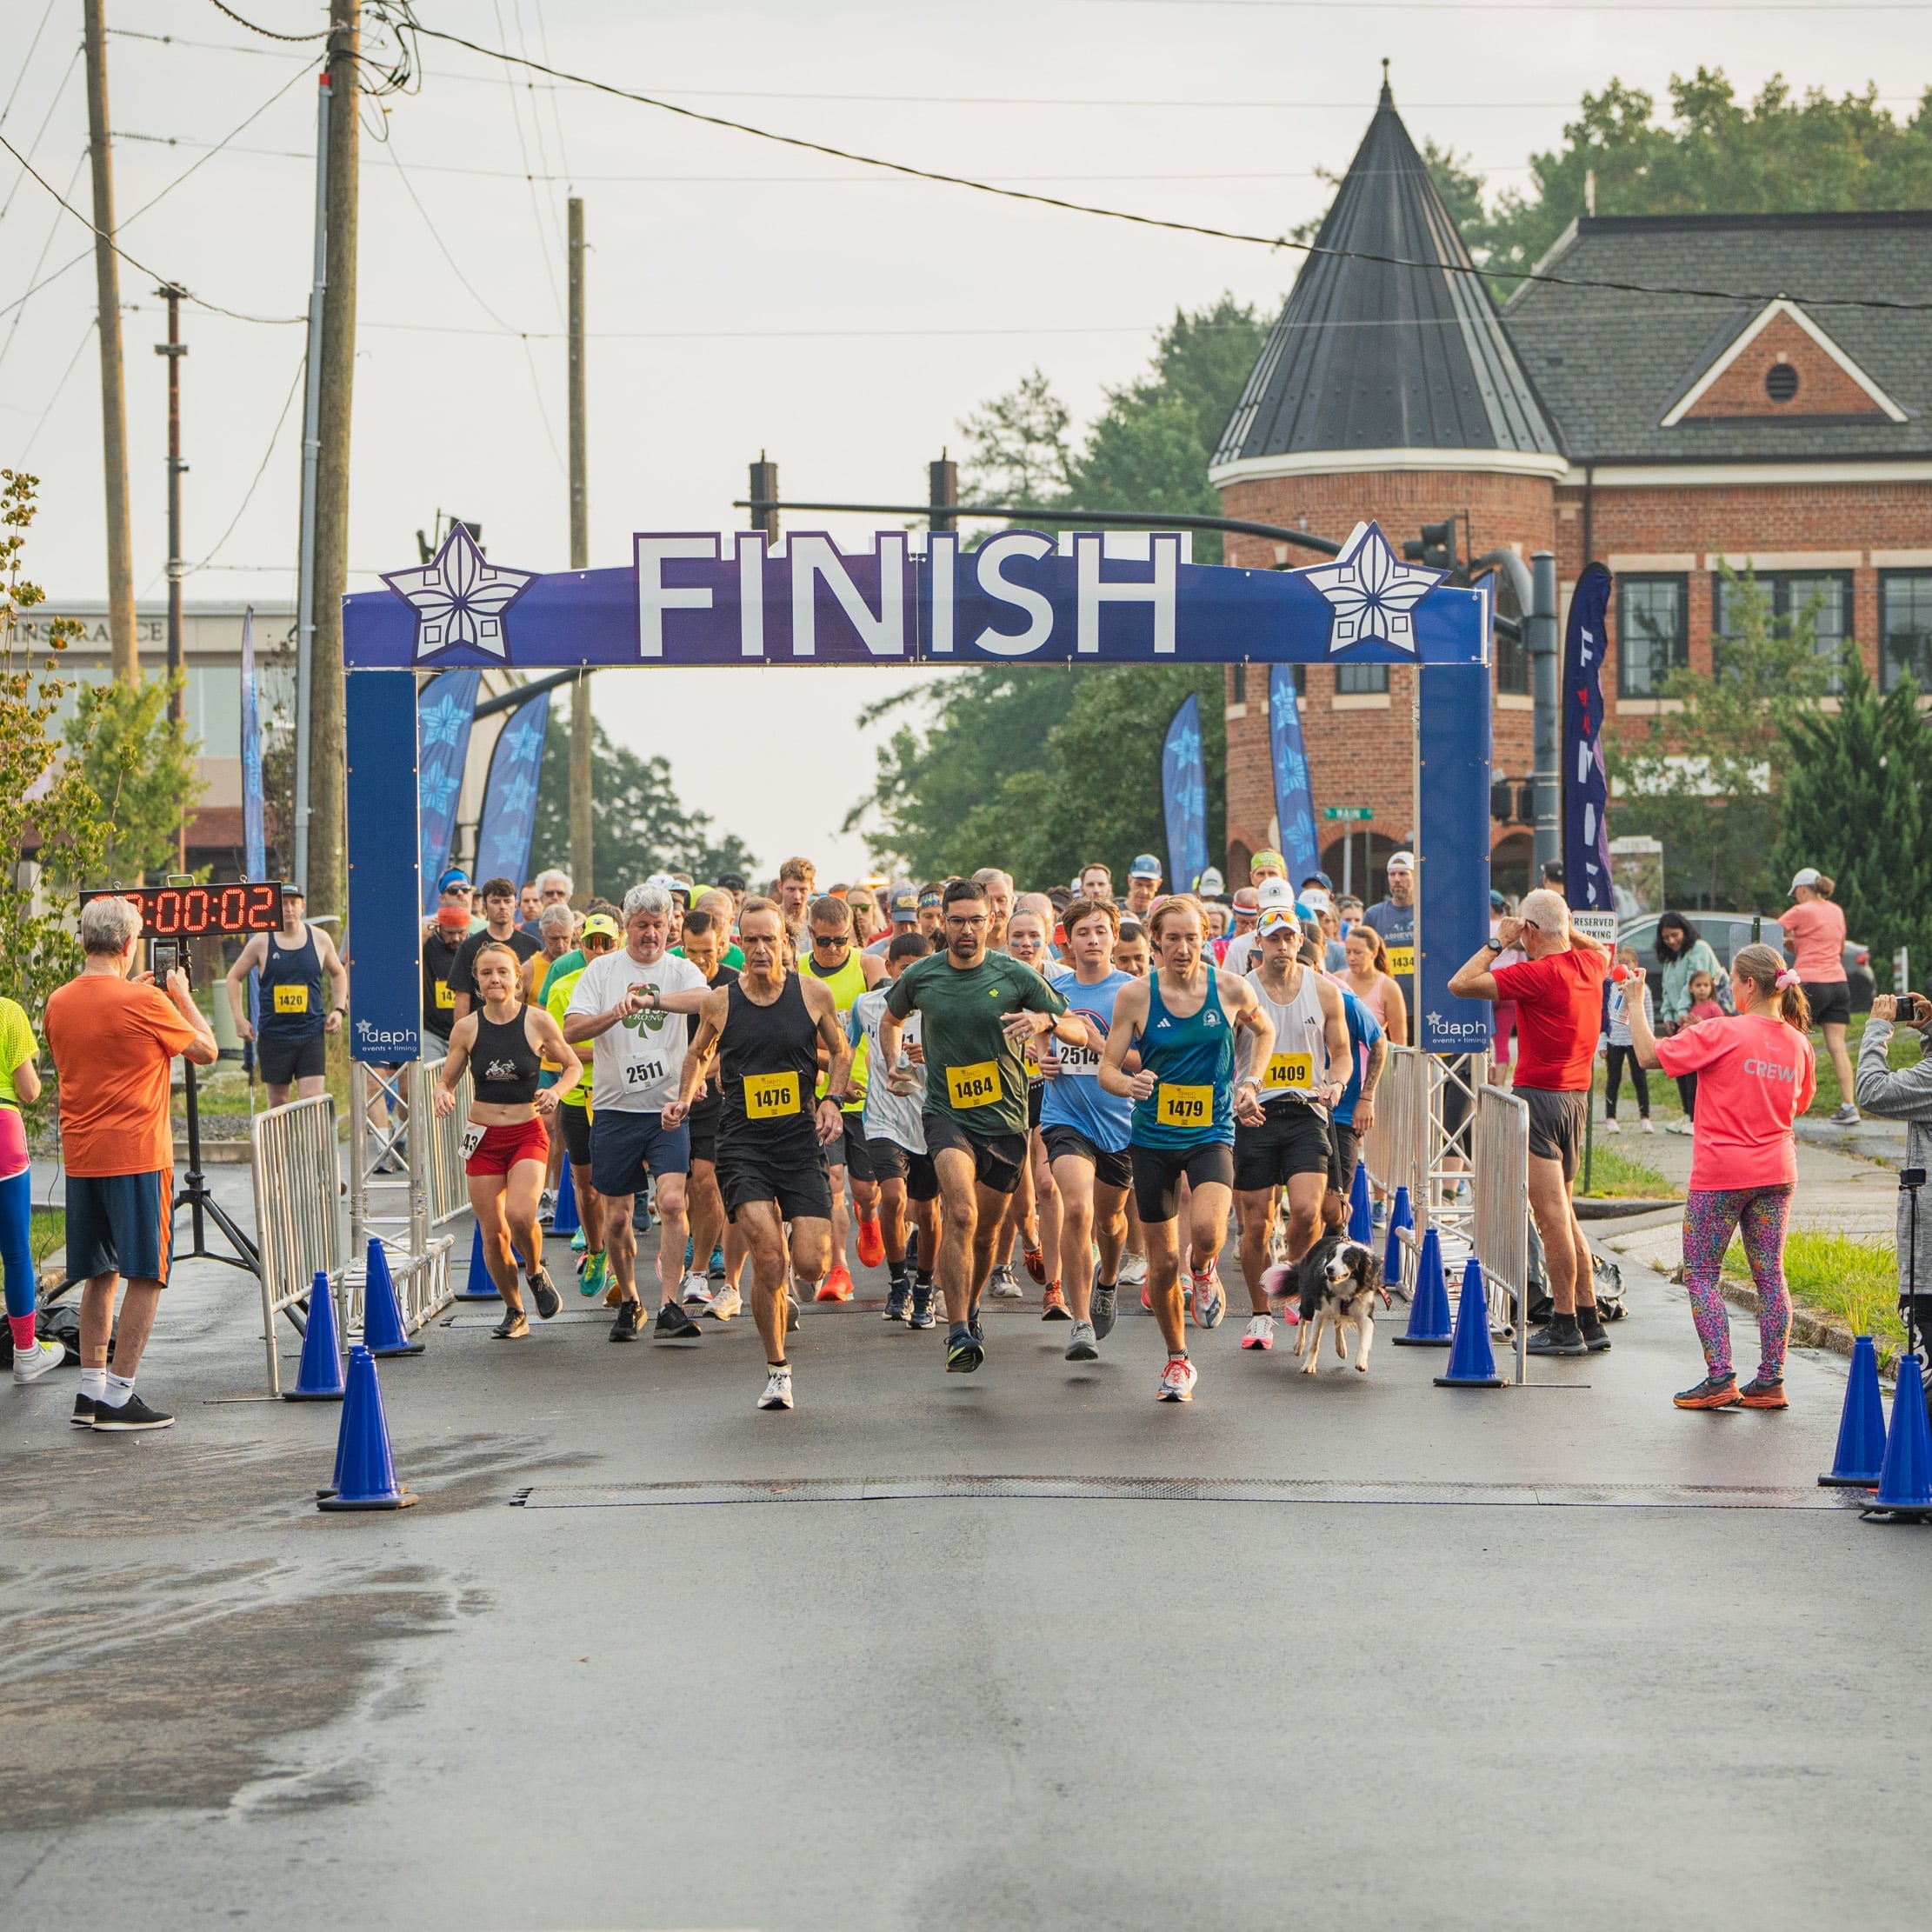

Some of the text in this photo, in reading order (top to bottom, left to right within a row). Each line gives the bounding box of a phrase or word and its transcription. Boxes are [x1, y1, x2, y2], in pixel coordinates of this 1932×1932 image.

[637, 533, 1176, 657] FINISH
[1574, 917, 1614, 927] RESERVED
[1582, 930, 1611, 939] RKING
[1392, 956, 1415, 968] 1434
[279, 996, 303, 1006] 1420
[362, 1028, 417, 1045] idaph
[1432, 1020, 1487, 1037] idaph
[1061, 1047, 1100, 1065] 2514
[626, 1060, 664, 1084] 2511
[1270, 1065, 1305, 1082] 1409
[1743, 1058, 1796, 1083] CREW
[955, 1076, 993, 1098] 1484
[754, 1087, 791, 1108] 1476
[1167, 1099, 1203, 1117] 1479
